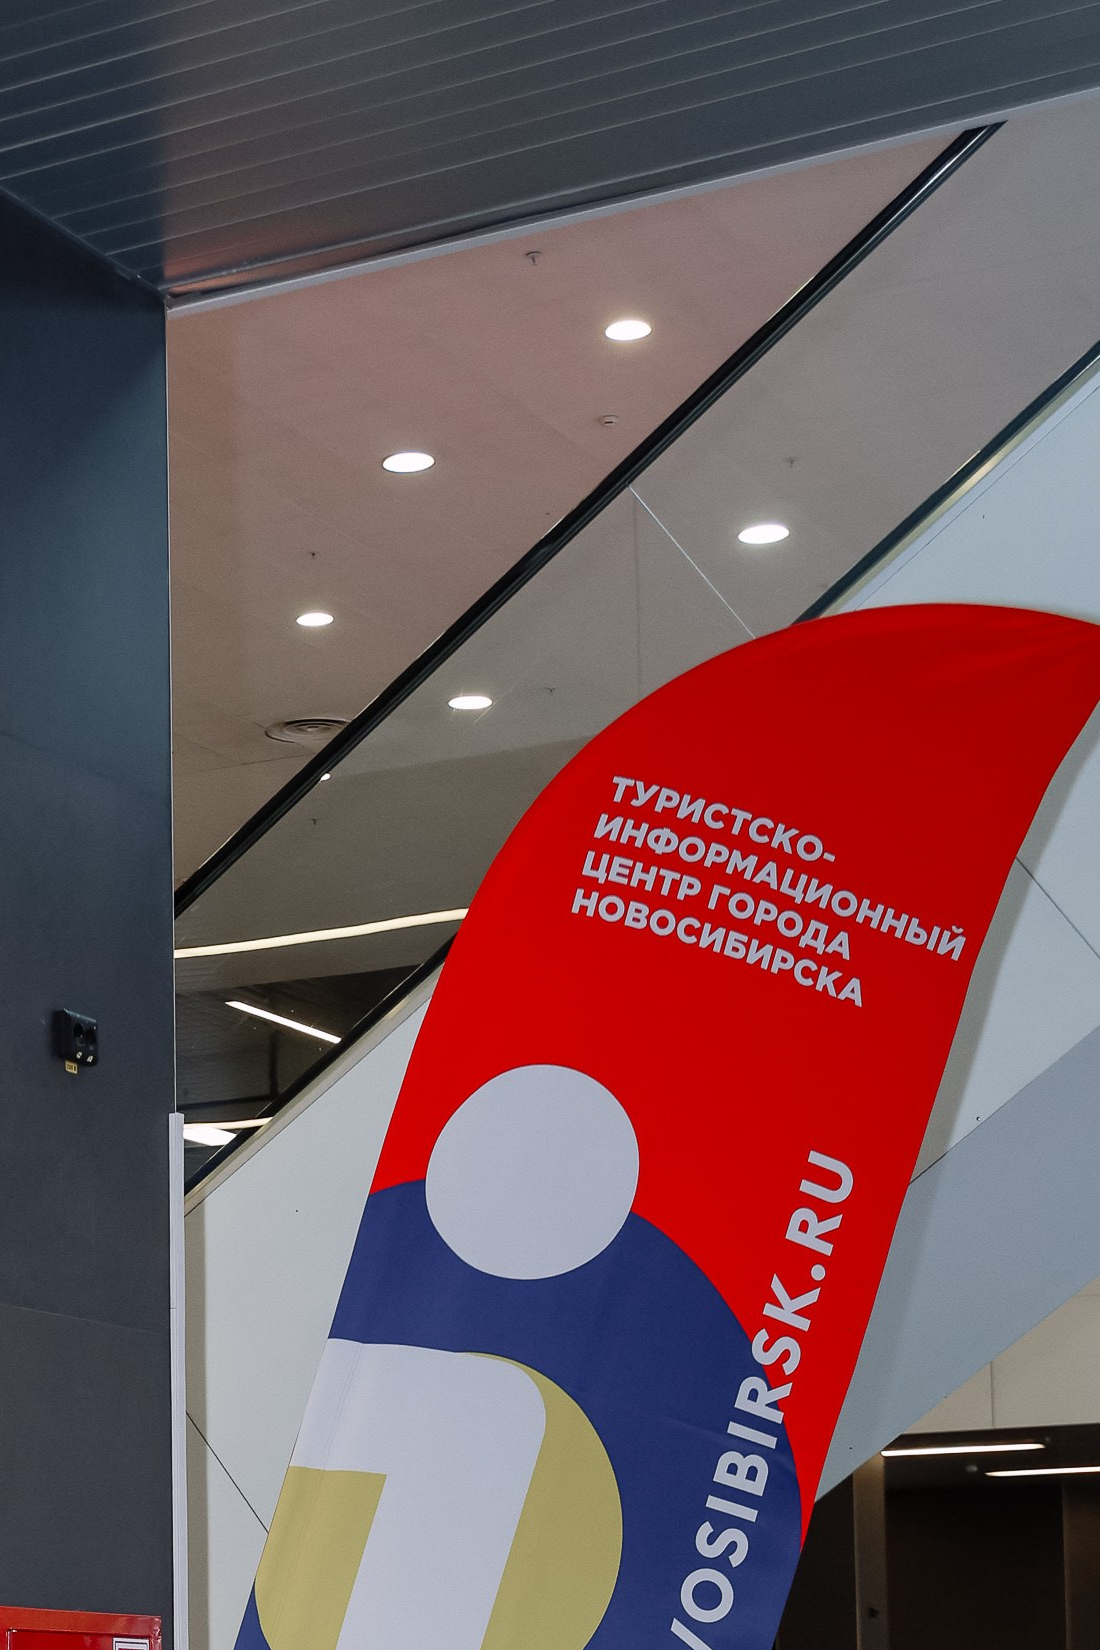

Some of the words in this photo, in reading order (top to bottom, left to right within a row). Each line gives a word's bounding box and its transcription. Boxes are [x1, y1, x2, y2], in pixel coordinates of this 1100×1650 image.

[612, 776, 836, 862] ТУРИСТСКО-
[581, 850, 702, 901] ЦЕНТР
[707, 884, 850, 961] ГОРОДА
[593, 813, 966, 961] ИНФОРМАЦИОННЫЙ
[571, 888, 862, 1008] НОВОСИБИРСКА
